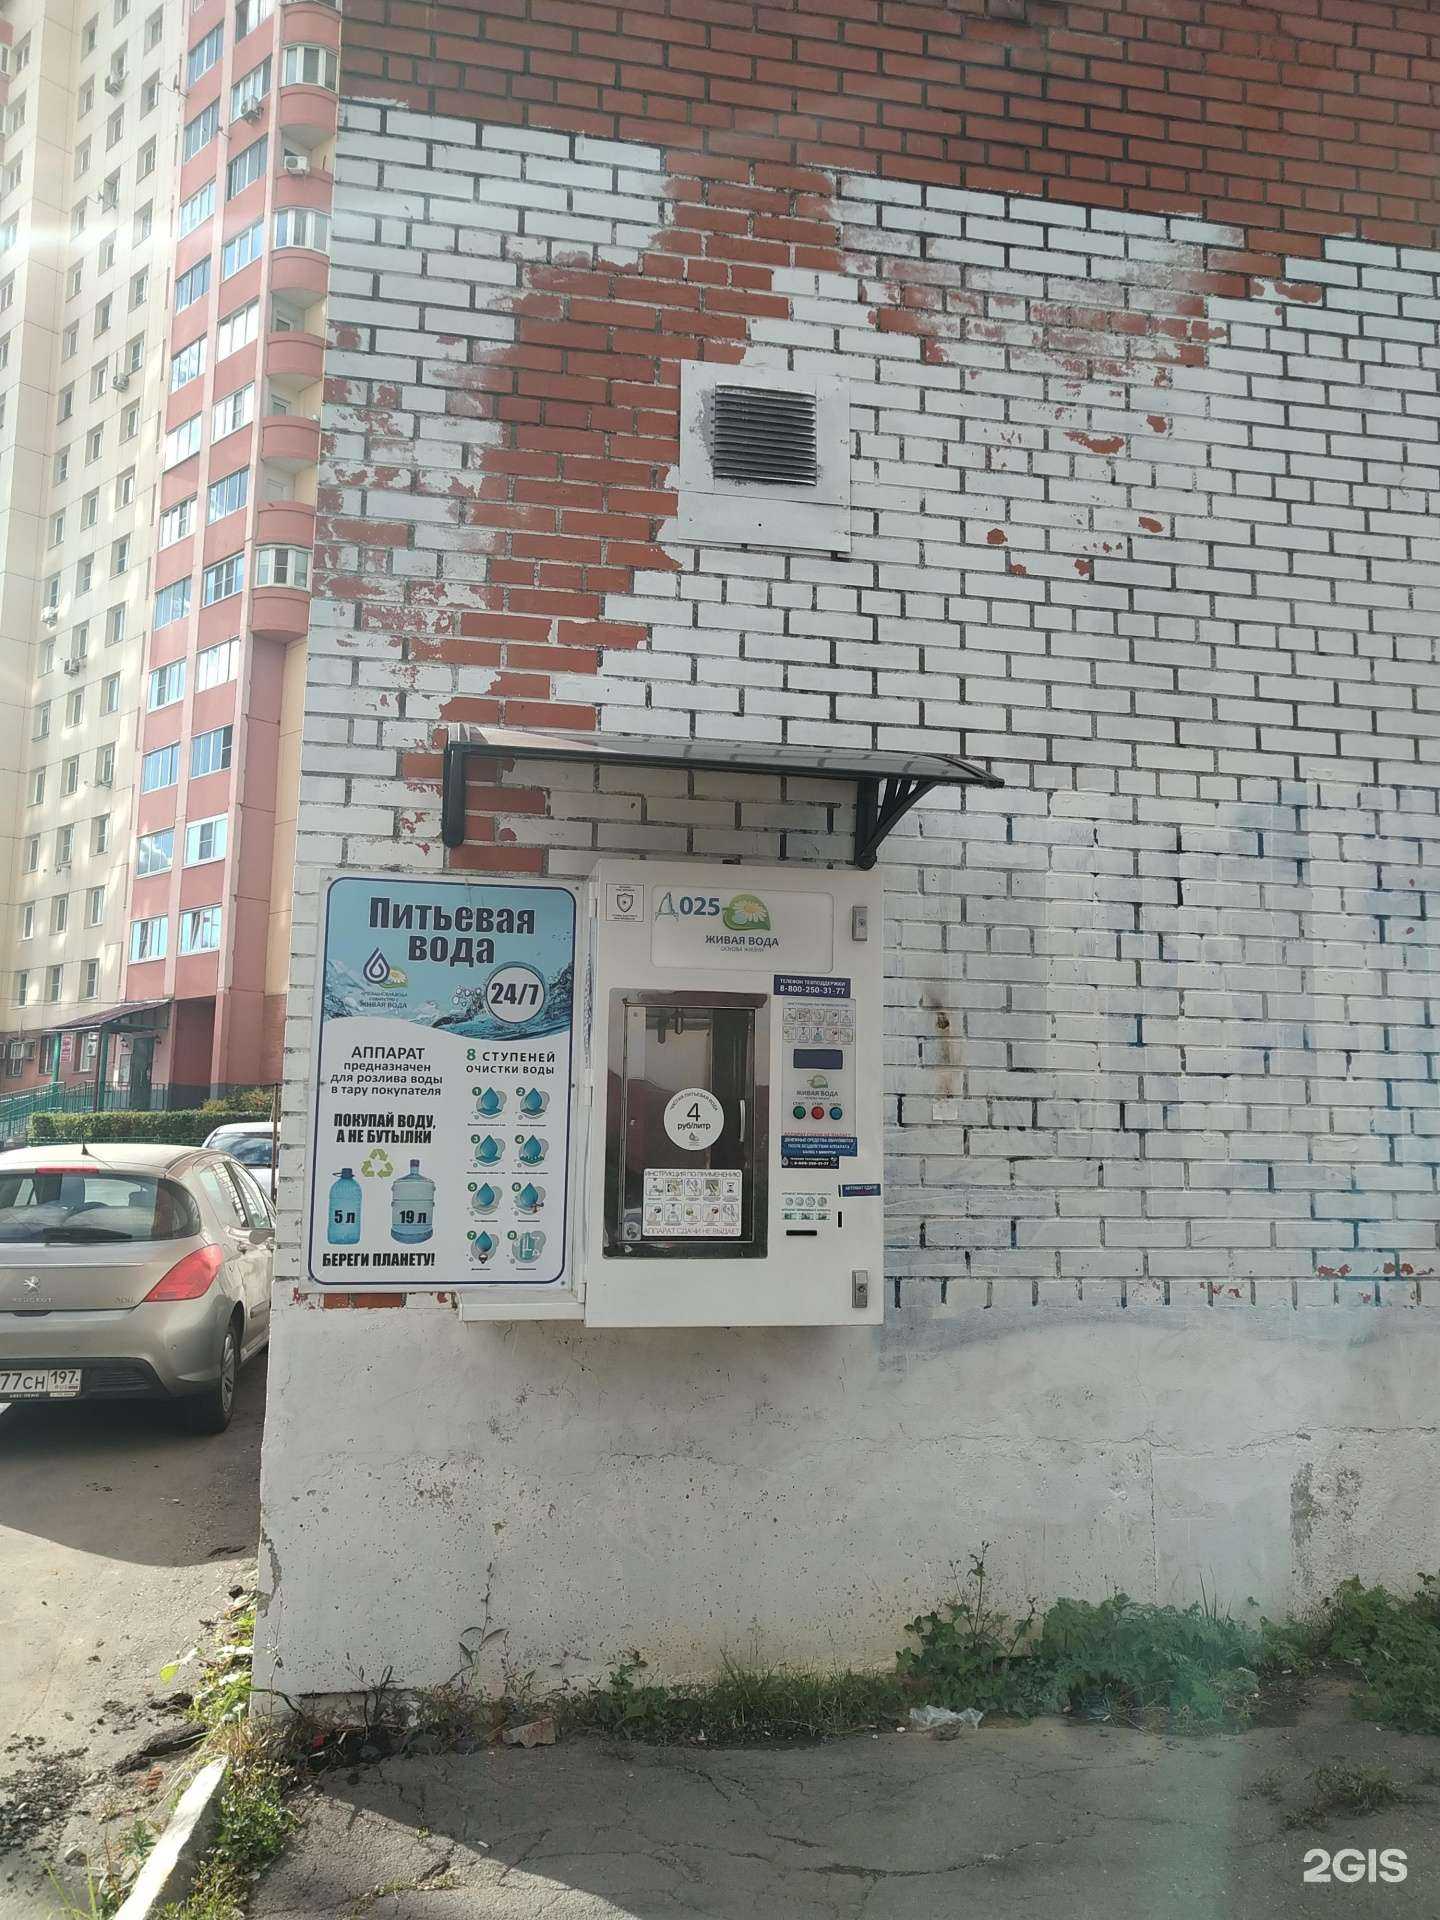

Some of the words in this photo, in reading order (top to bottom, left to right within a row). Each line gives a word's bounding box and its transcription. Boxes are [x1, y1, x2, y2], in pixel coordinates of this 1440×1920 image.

[369, 896, 535, 934] Питьевая
[705, 935, 745, 944] ЖИВАЯ
[748, 936, 778, 948] ВОДА
[408, 935, 495, 967] вода
[490, 982, 539, 1005] 24/7
[780, 985, 845, 994] 8-800-250-31-77
[352, 1046, 425, 1060] АППАРАТ
[466, 1048, 476, 1060] 8
[482, 1050, 555, 1062] СТУПЕНЕЙ
[344, 1062, 431, 1073] предназначен
[466, 1064, 518, 1074] ОЧИСТКИ
[522, 1066, 554, 1075] ВОДЫ
[330, 1074, 354, 1084] для
[357, 1075, 407, 1084] розлива
[410, 1076, 443, 1085] воды
[340, 1087, 368, 1097] тару
[372, 1088, 442, 1098] покупателя
[686, 1103, 701, 1122] 4
[334, 1112, 394, 1128] ПОКУПАЙ
[397, 1115, 436, 1130] ВОДУ,
[678, 1122, 711, 1130] руб/литр
[336, 1130, 345, 1143] А
[348, 1130, 364, 1143] НЕ
[367, 1130, 432, 1144] БУТЫЛКИ
[334, 1210, 343, 1224] 5
[346, 1212, 356, 1224] л
[400, 1210, 415, 1224] 19
[417, 1212, 427, 1224] л
[322, 1252, 368, 1266] БЕРЕГИ
[372, 1252, 435, 1267] ПЛАНЕТУ!
[50, 1371, 76, 1384] 197
